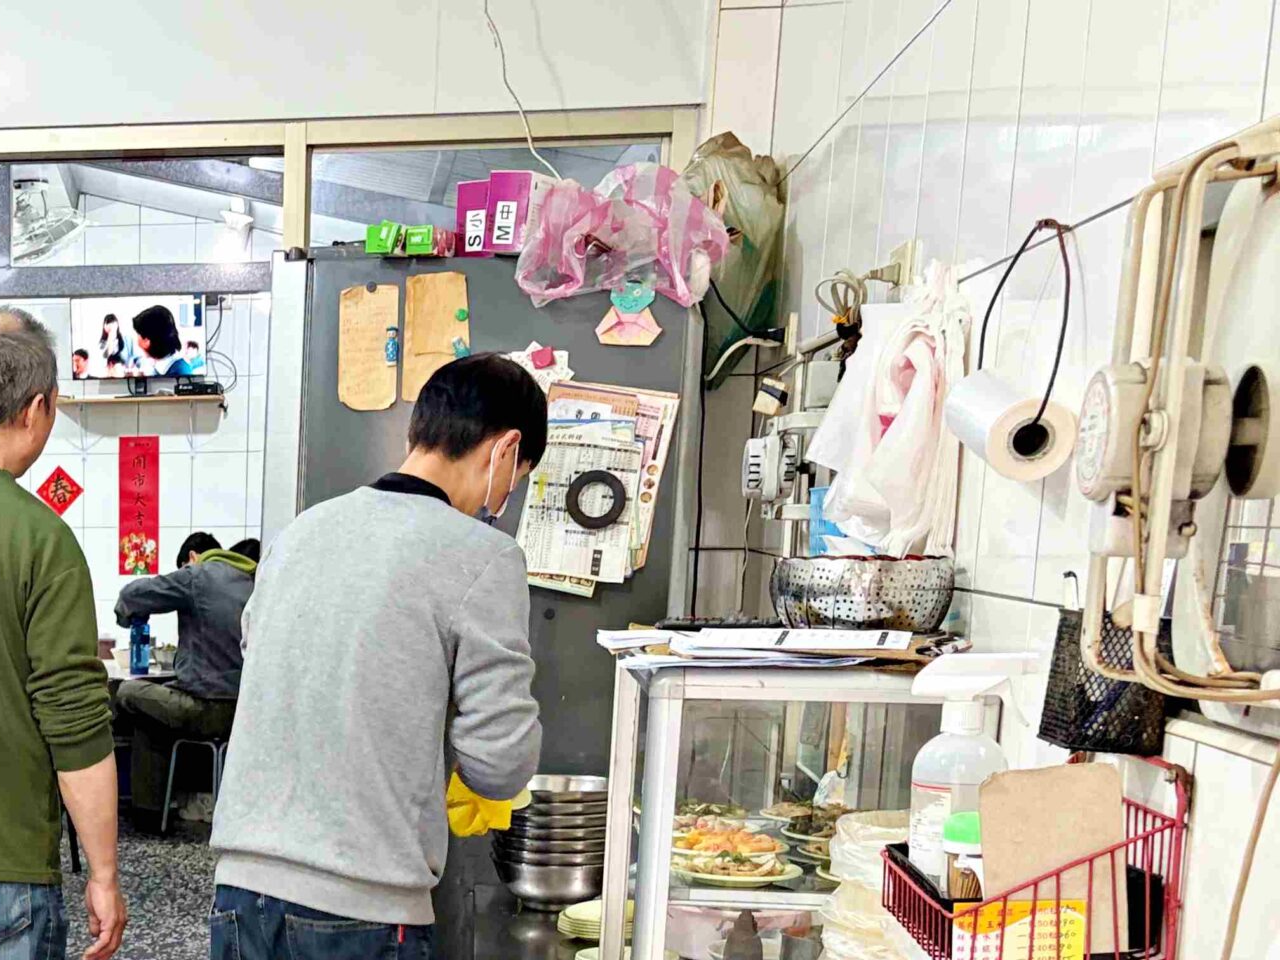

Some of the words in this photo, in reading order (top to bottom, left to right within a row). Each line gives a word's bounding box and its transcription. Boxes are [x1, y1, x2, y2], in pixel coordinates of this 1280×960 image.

[499, 205, 513, 219] 中
[469, 213, 482, 228] 小
[495, 226, 512, 241] M
[51, 474, 73, 504] 春
[132, 454, 147, 527] 開市大吉
